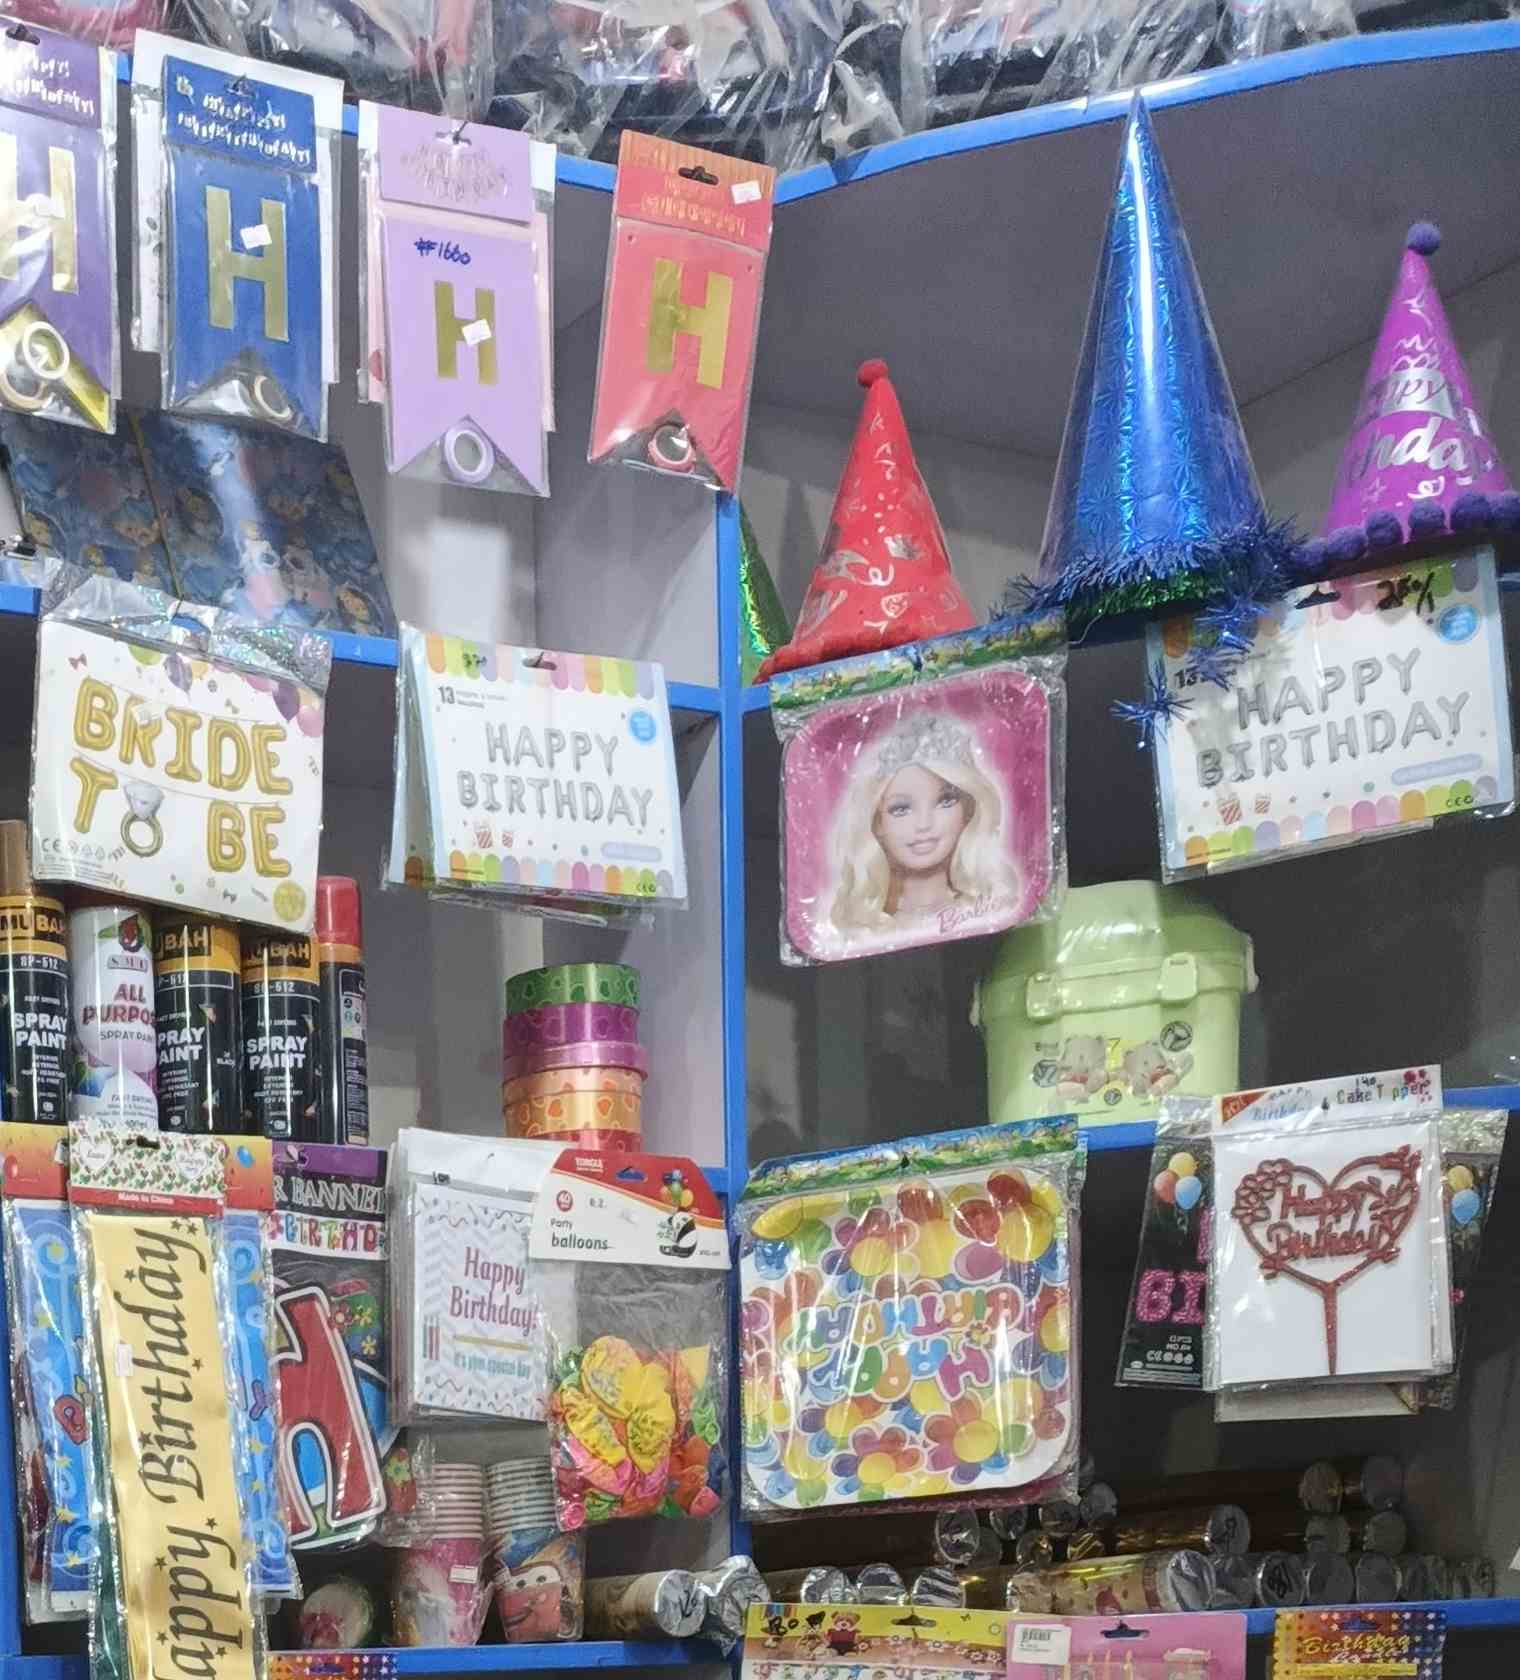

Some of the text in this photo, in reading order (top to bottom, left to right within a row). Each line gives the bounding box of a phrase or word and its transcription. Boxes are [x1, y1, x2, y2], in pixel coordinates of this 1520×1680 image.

[205, 185, 289, 342] H
[433, 280, 498, 385] H
[645, 257, 733, 389] H
[438, 686, 455, 704] 13
[1236, 648, 1421, 730] HAPPY
[73, 675, 292, 795] BRIDE
[484, 721, 618, 776] HAPPY
[1195, 691, 1470, 788] BIRTHDAY
[456, 770, 653, 827] BIRTHDAY
[207, 800, 291, 877] BE
[936, 893, 1001, 933] Barbie
[83, 1005, 155, 1026] PURPO
[114, 984, 146, 1003] ALL
[14, 1012, 67, 1032] SPRAY
[16, 1031, 67, 1050] PAINT
[158, 1026, 205, 1047] PRAY
[159, 1045, 202, 1065] AINT
[247, 1036, 307, 1053] SPRAY
[249, 1053, 306, 1070] PAINT
[1336, 1079, 1432, 1104] Cake Tpper
[550, 1217, 573, 1230] Party
[1279, 1182, 1367, 1232] Happy
[284, 1213, 385, 1252] BIRTHD
[551, 1232, 608, 1250] balloons
[464, 1246, 526, 1295] Happy
[449, 1285, 539, 1337] Birthday!
[113, 1227, 207, 1503] Birthday
[152, 1524, 243, 1680] appy
